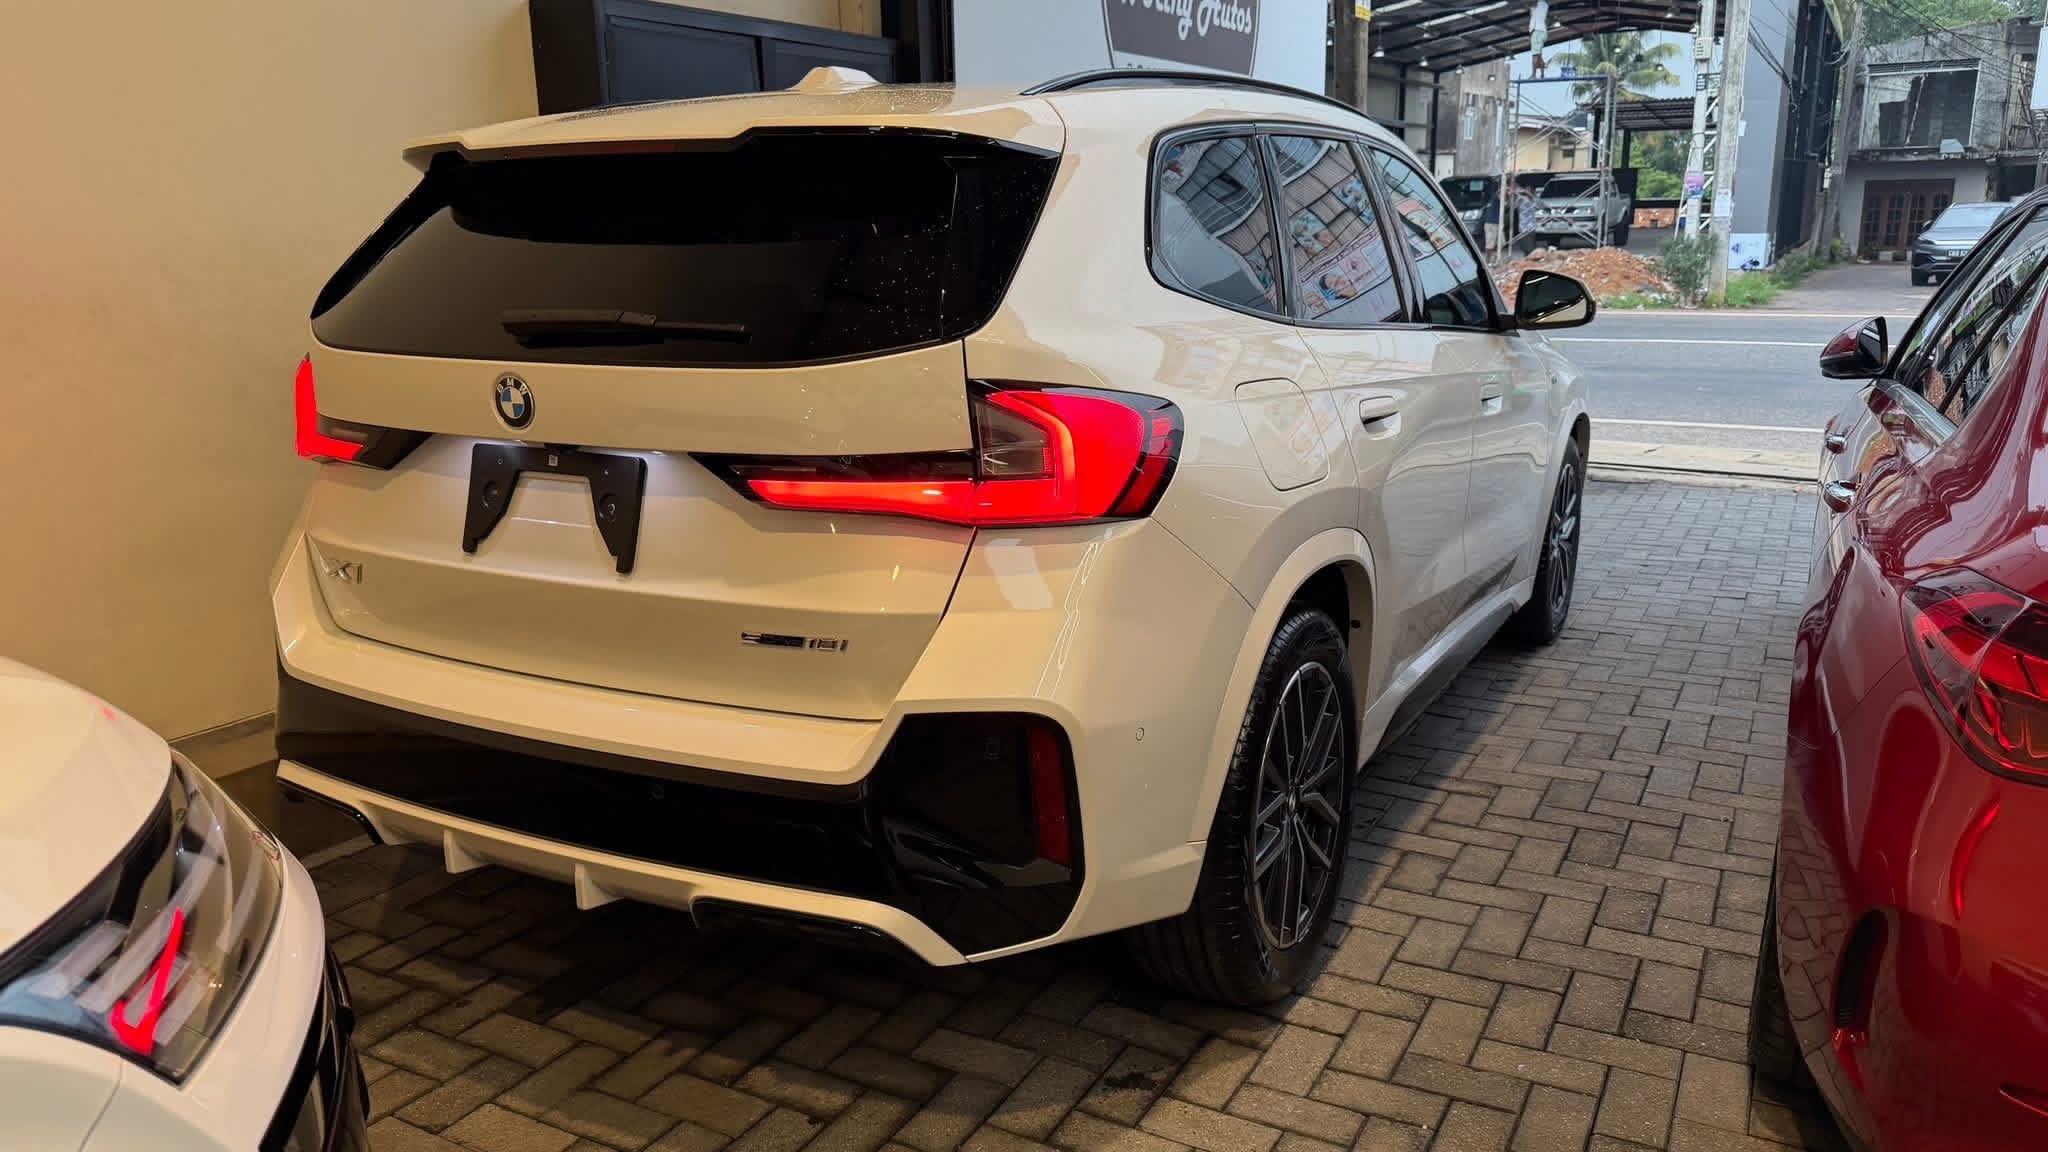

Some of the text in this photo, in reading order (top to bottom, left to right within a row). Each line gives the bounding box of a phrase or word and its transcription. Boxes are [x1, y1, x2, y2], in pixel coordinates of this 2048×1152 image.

[1197, 0, 1252, 36] Autos
[496, 377, 528, 396] BMW
[327, 560, 363, 585] X1
